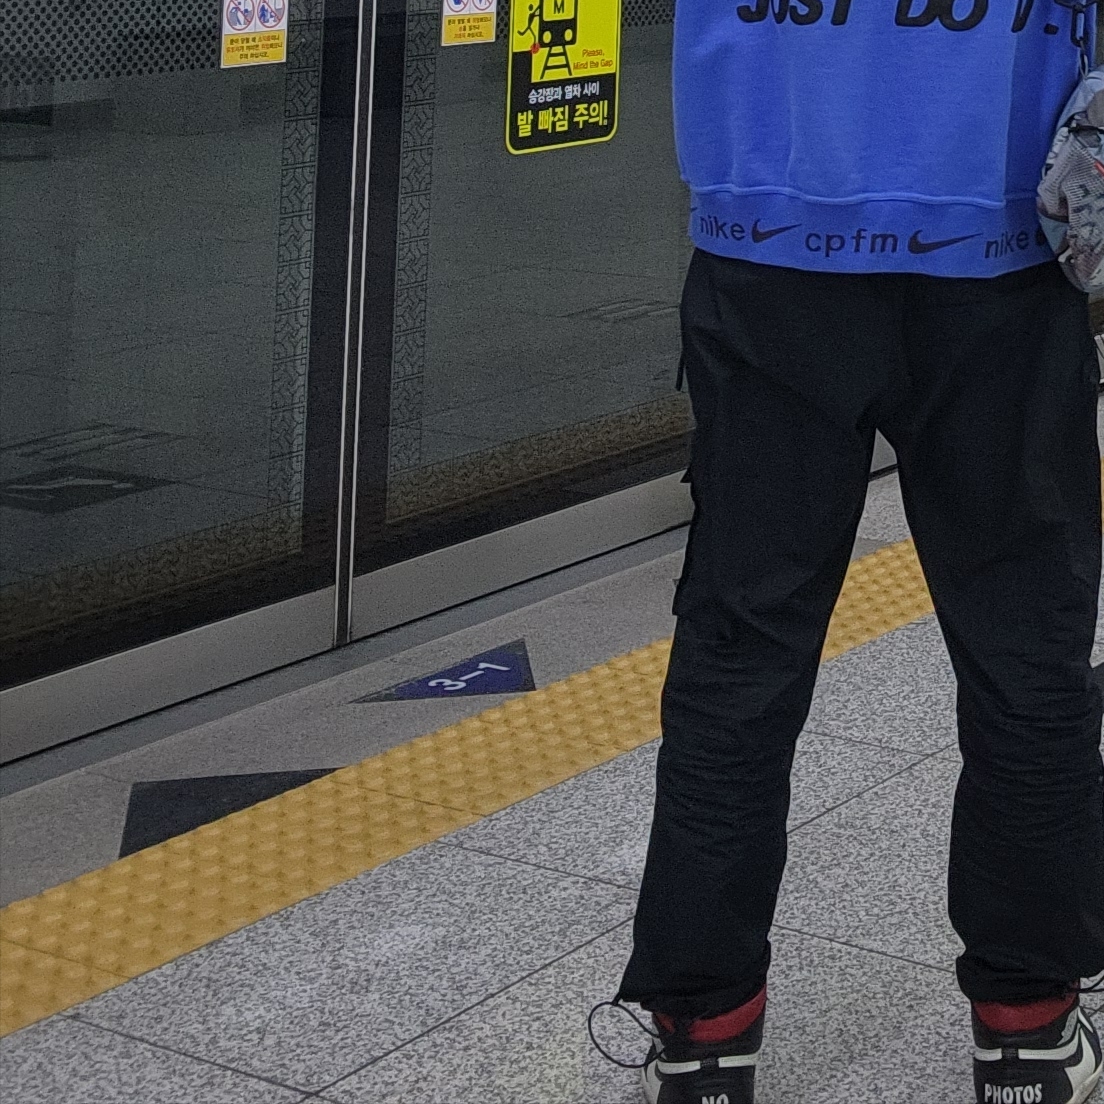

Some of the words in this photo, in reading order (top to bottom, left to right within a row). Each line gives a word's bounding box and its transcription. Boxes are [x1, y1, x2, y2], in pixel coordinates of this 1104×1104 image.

[600, 59, 613, 68] Gap
[528, 85, 563, 104] 승강장과
[564, 83, 581, 100] 열차
[583, 80, 600, 96] 사이
[517, 110, 533, 137] 발
[538, 105, 569, 133] 빠짐
[573, 99, 608, 129] 주의!
[700, 215, 746, 241] nike
[805, 229, 898, 257] cpfm
[985, 229, 1029, 258] nike
[428, 662, 510, 691] 3-1
[985, 1083, 1042, 1104] PHOTOS
